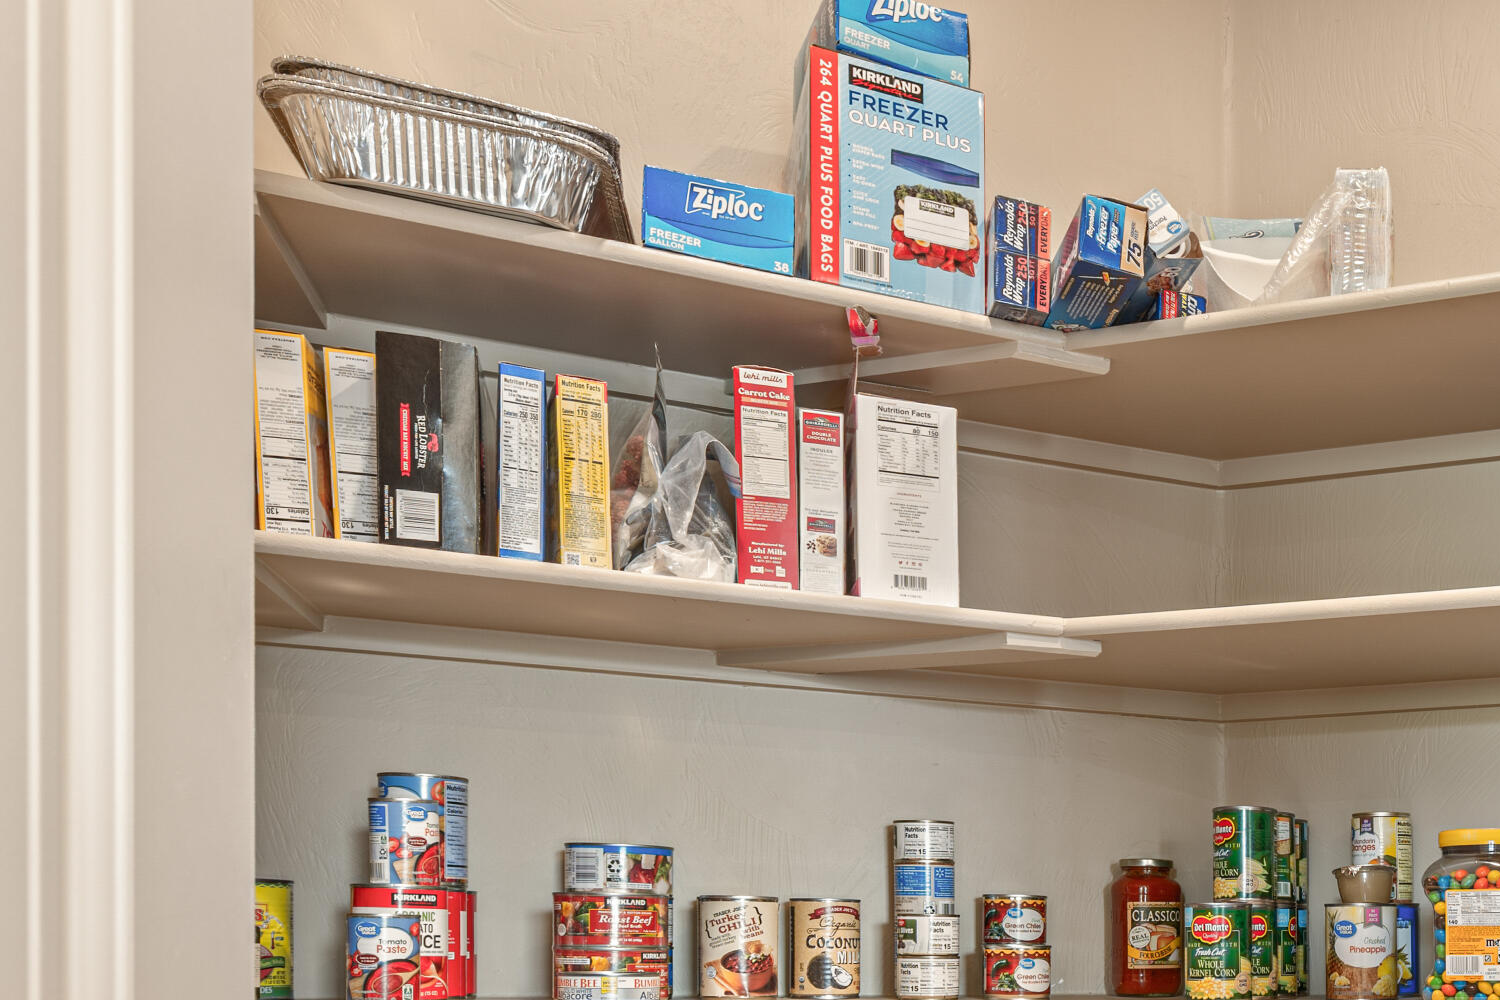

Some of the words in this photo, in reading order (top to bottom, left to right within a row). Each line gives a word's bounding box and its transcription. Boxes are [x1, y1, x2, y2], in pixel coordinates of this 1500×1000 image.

[844, 36, 871, 50] QUART
[845, 26, 890, 50] FREEZER
[820, 59, 832, 84] 264
[950, 70, 964, 83] 54
[852, 67, 922, 95] KIRKLAND
[848, 90, 949, 130] FREEZER
[817, 91, 832, 145] QUART
[848, 110, 916, 138] QUART
[922, 128, 972, 153] PLUS
[820, 146, 833, 182] PLUS
[692, 186, 764, 221] Ziploc
[820, 186, 833, 230] FOOD
[1003, 200, 1016, 246] Reynolds
[648, 236, 684, 250] GALLON
[649, 227, 702, 248] FREEZER
[1012, 223, 1024, 252] Wrap
[821, 233, 834, 272] BAGS
[1127, 241, 1143, 268] 75
[774, 260, 790, 272] 38
[1016, 256, 1028, 281] 250
[1002, 254, 1014, 300] Reynolds
[1012, 278, 1024, 306] Wrap
[562, 380, 585, 389] Nutrition
[586, 384, 600, 392] Facts
[738, 387, 768, 398] Carrot
[768, 391, 790, 401] Cake
[742, 407, 769, 416] Nutrition
[877, 405, 910, 416] Nutrition
[912, 410, 932, 420] Facts
[806, 434, 836, 443] CHOCOLATE
[812, 430, 832, 438] DOUBLE
[417, 432, 428, 470] LOBSTER
[266, 507, 279, 515] 130
[748, 546, 766, 554] Lehi
[766, 548, 787, 556] Mills
[904, 832, 918, 840] Facts
[393, 893, 437, 902] KIRKLAND
[632, 915, 652, 926] Beef
[1132, 910, 1180, 922] CLASSICO
[1004, 922, 1024, 930] Green
[1204, 922, 1230, 932] Monte
[378, 938, 408, 946] Tomato
[376, 945, 408, 954] Paste
[1350, 946, 1386, 954] Pineapple
[1198, 960, 1224, 968] WHOLE
[1189, 968, 1214, 977] KERNEL
[1214, 967, 1236, 977] CORN
